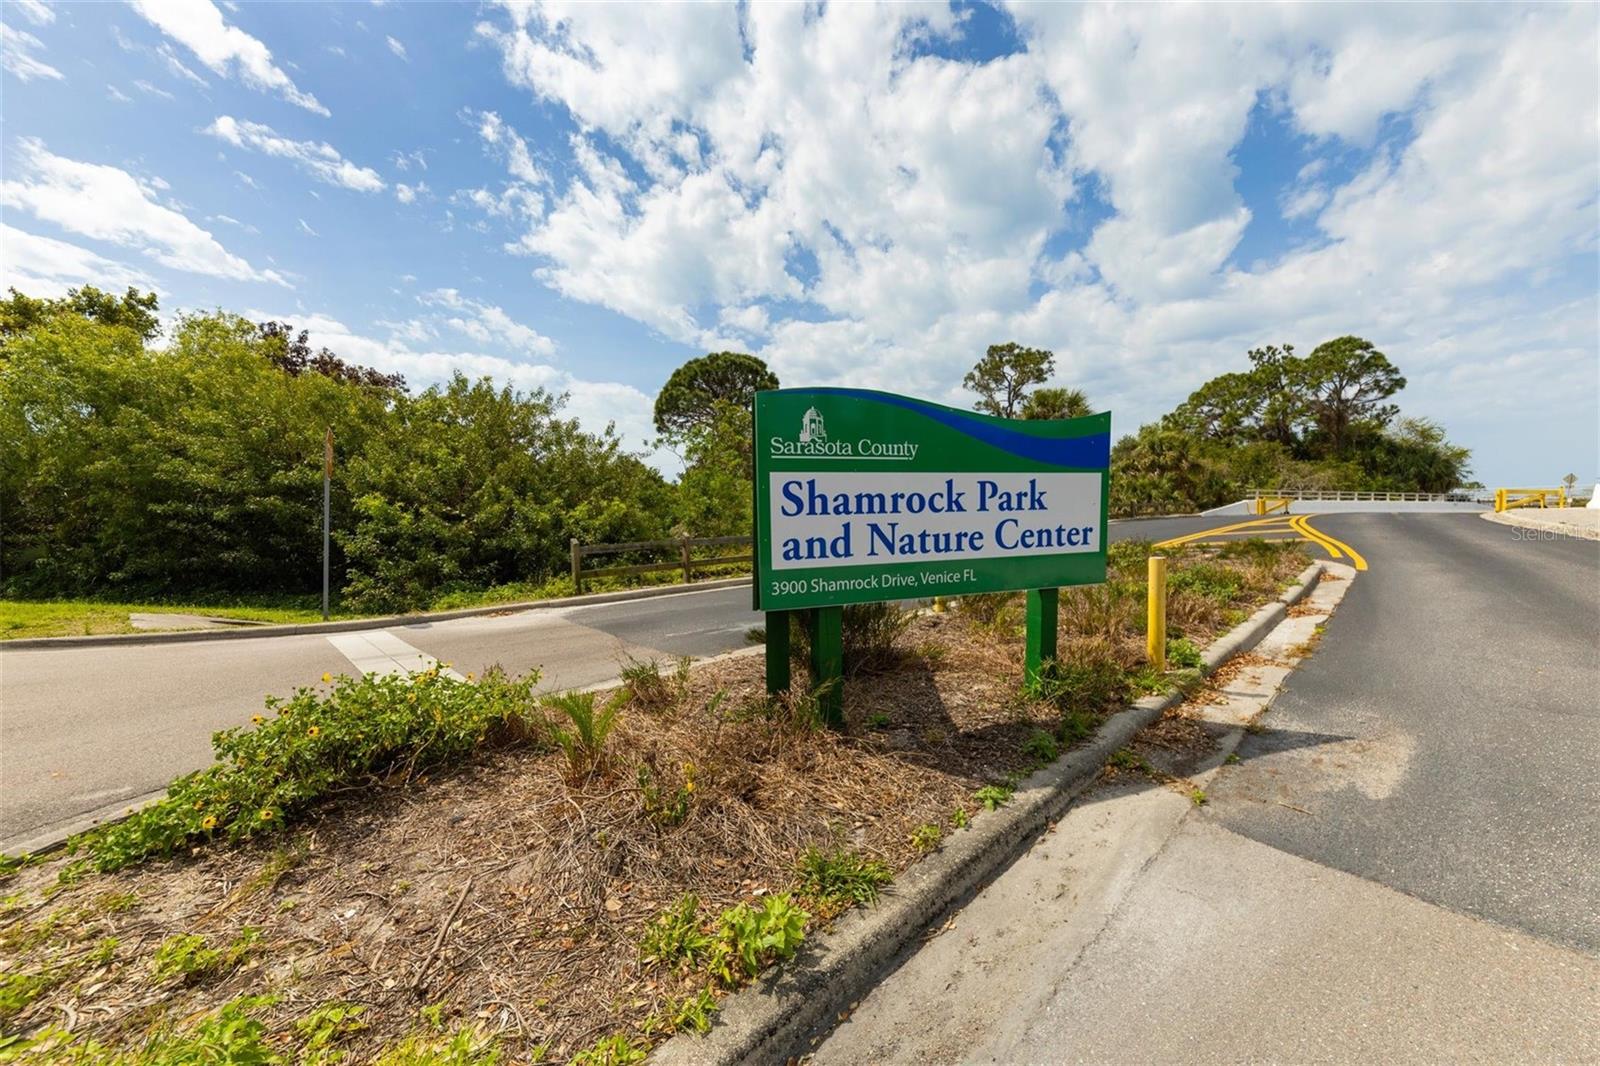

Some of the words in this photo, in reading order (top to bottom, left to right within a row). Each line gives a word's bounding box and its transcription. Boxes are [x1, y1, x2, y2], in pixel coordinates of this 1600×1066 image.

[770, 437, 853, 456] Sarasota
[857, 439, 919, 460] County
[780, 478, 967, 517] Shamrock
[976, 478, 1048, 512] Park
[782, 521, 854, 561] and
[866, 522, 984, 557] Nature
[994, 518, 1094, 550] Center
[771, 580, 807, 596] 3900
[810, 576, 879, 593] Shamrock
[882, 574, 918, 588] Drive,
[920, 571, 962, 585] Venice
[964, 569, 977, 582] FL
